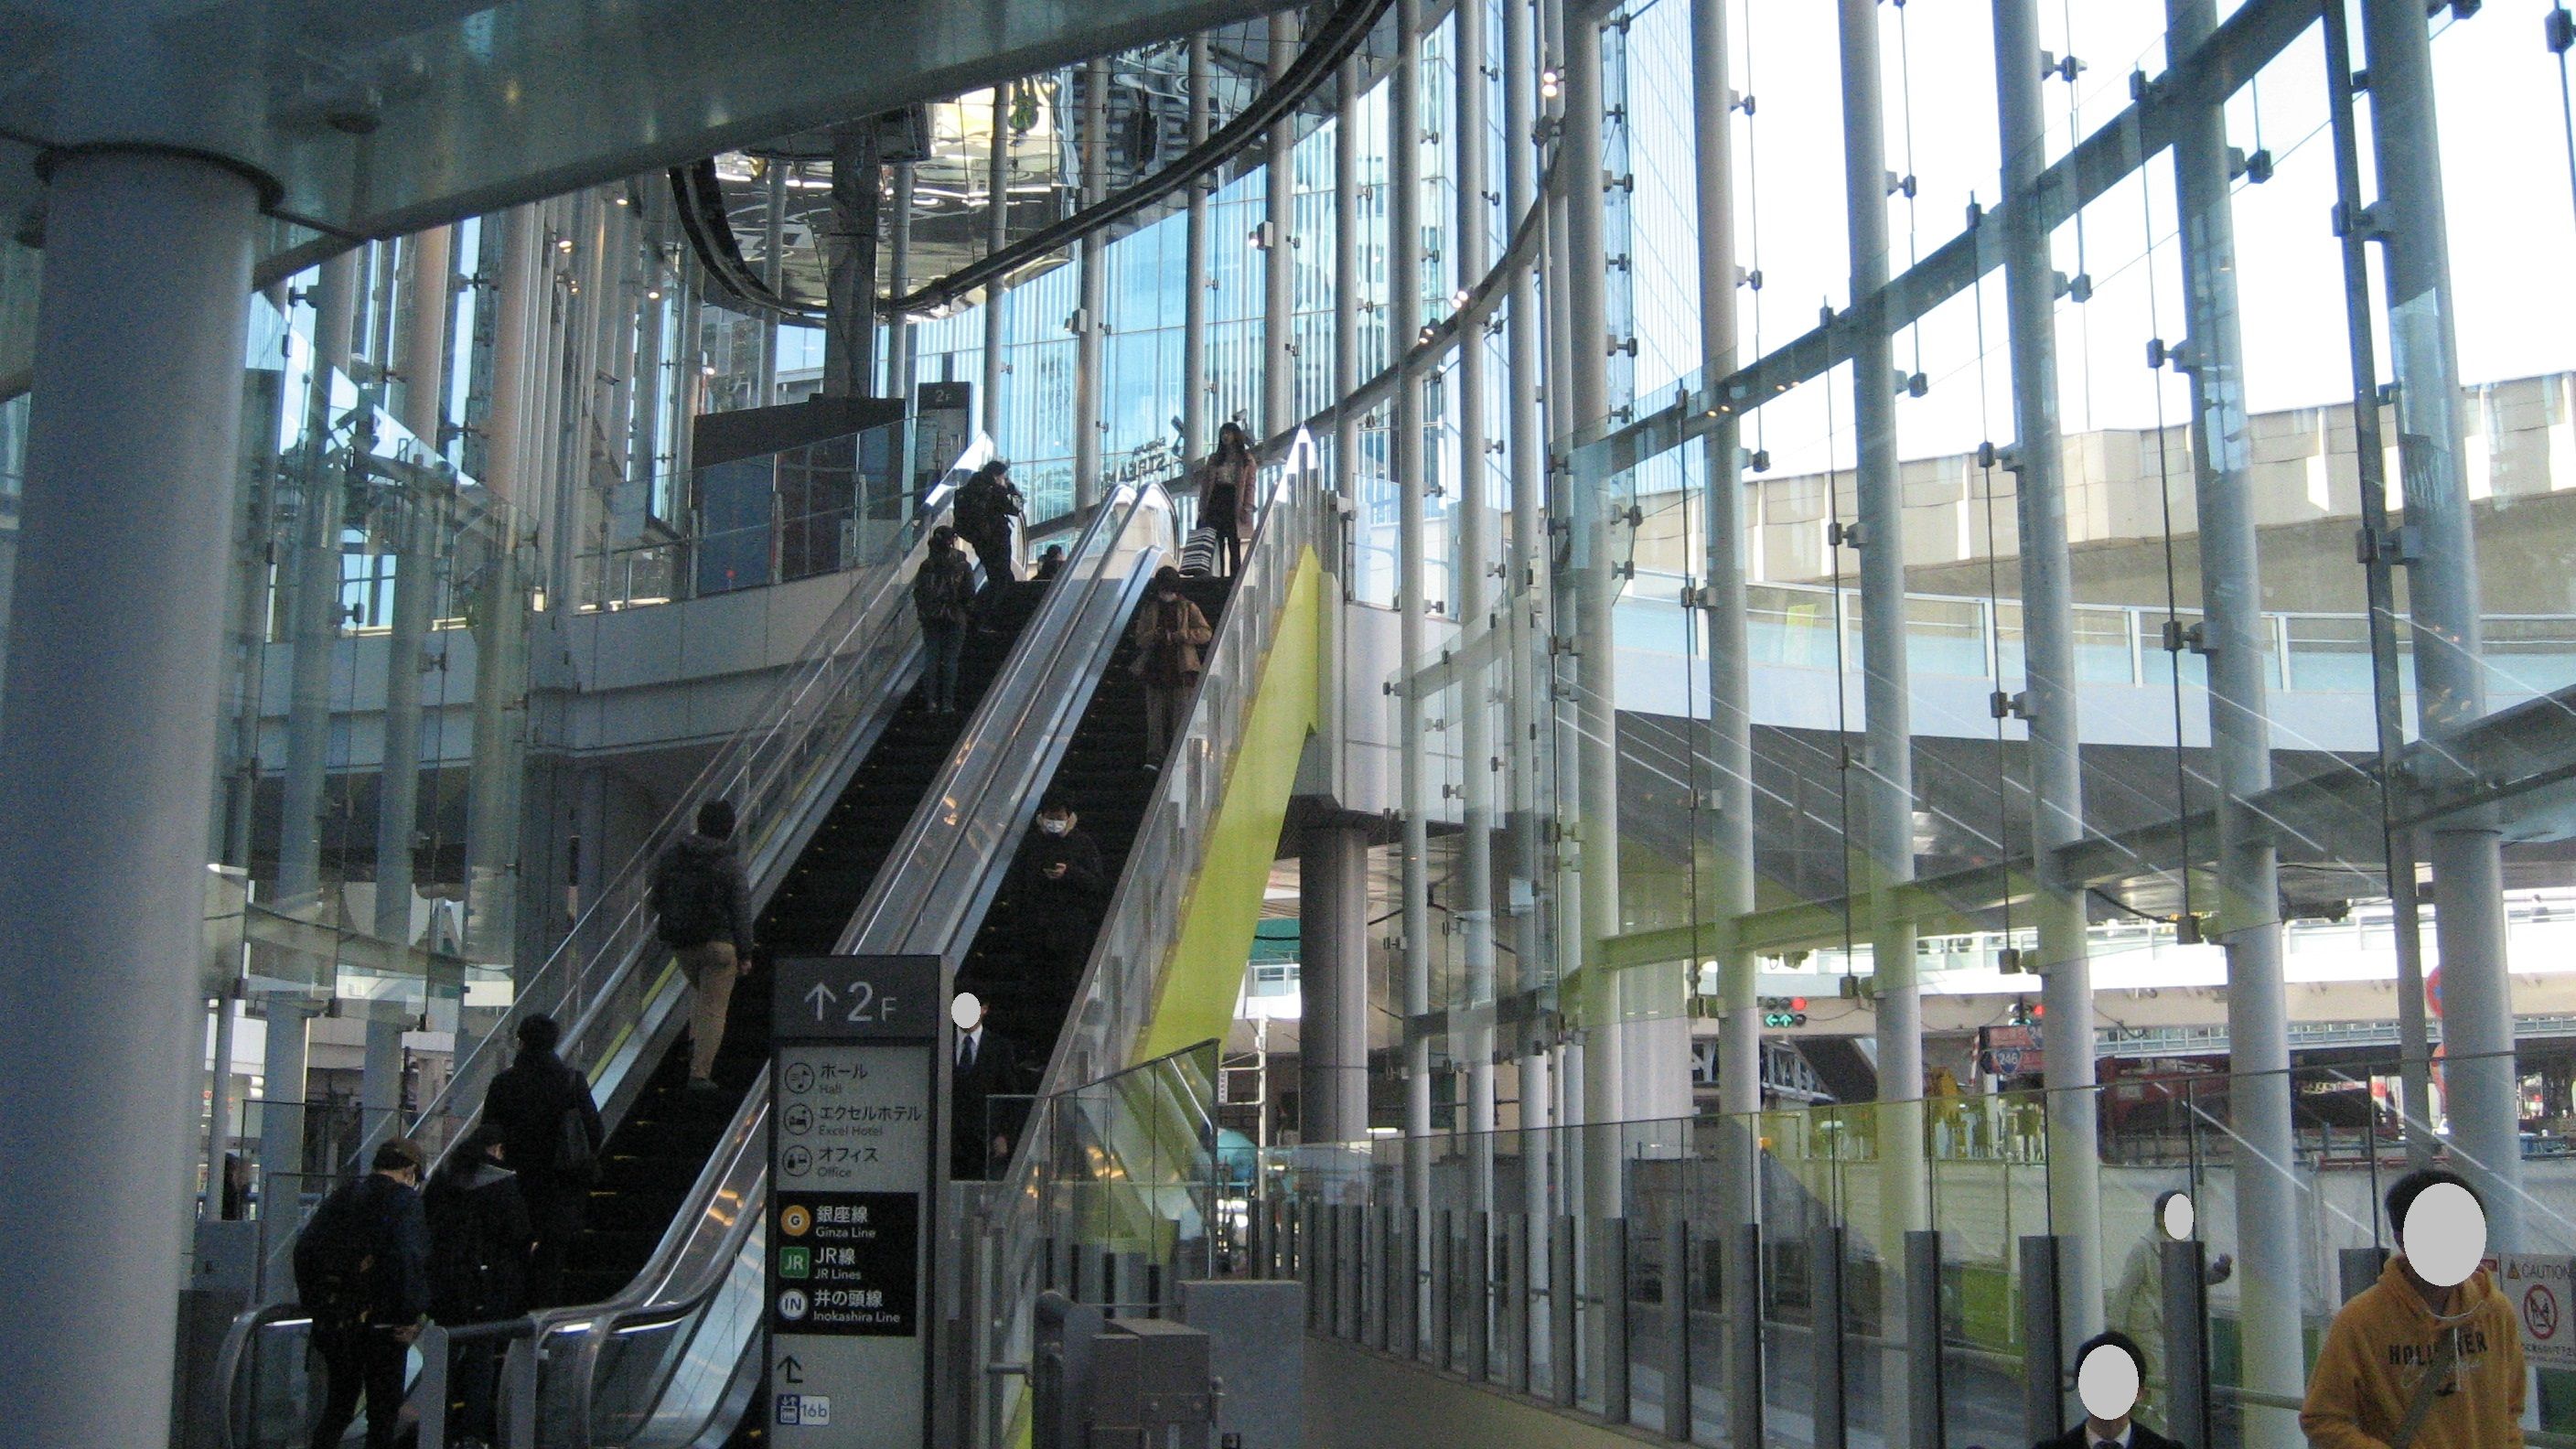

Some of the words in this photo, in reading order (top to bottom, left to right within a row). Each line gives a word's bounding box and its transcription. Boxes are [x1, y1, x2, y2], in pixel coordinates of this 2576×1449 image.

[847, 981, 897, 1022] 2F
[1998, 1053, 2018, 1064] 246
[821, 1064, 868, 1079] ホール
[820, 1084, 842, 1093] Hall
[821, 1106, 922, 1121] エクセルホテル
[819, 1125, 848, 1135] Excel
[853, 1126, 883, 1136] Hotel
[820, 1147, 878, 1163] オフィス
[818, 1167, 851, 1177] Office
[816, 1206, 867, 1223] 銀座線
[816, 1227, 848, 1237] Ginza
[852, 1227, 875, 1238] Line
[785, 1255, 803, 1270] JR
[815, 1248, 855, 1265] JR線
[815, 1270, 828, 1279] JR
[832, 1270, 862, 1280] Lines
[785, 1298, 801, 1310] IN
[814, 1290, 883, 1307] 井の頭線
[814, 1311, 873, 1322] Inokashira
[876, 1312, 900, 1323] Line
[802, 1404, 827, 1417] 16b
